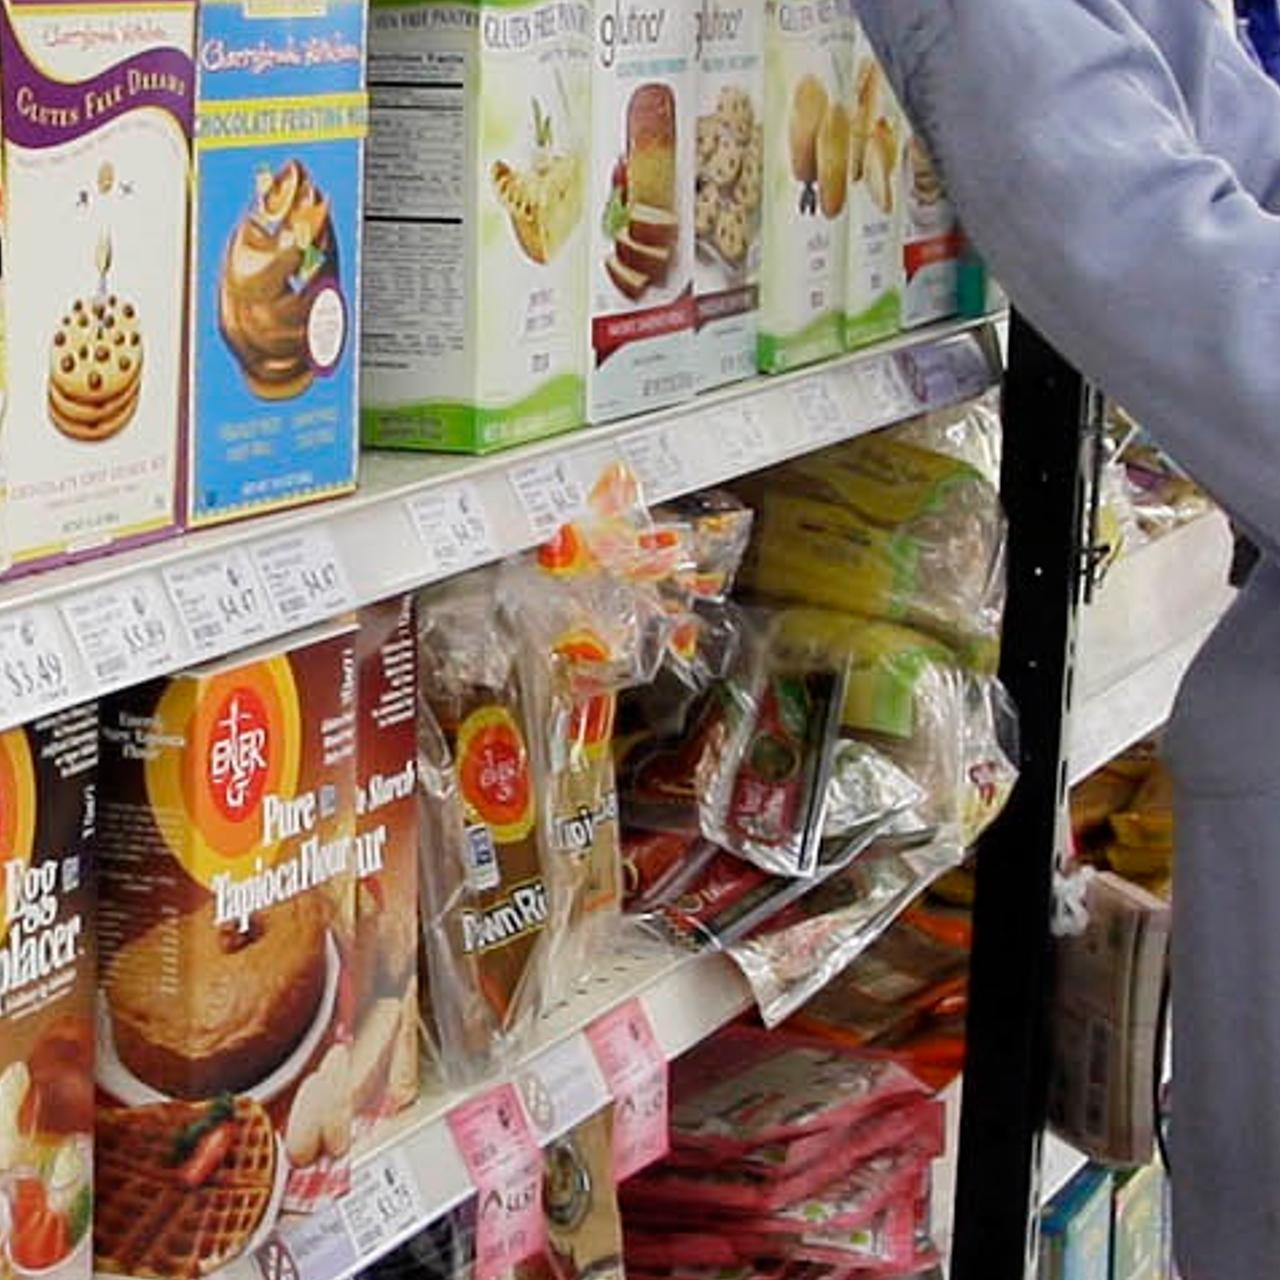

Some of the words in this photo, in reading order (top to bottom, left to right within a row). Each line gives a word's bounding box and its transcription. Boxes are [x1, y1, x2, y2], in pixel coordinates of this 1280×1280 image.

[261, 790, 318, 849] Pure
[3, 858, 59, 930] Egg
[212, 860, 302, 935] Tapioca
[299, 832, 355, 893] Flour
